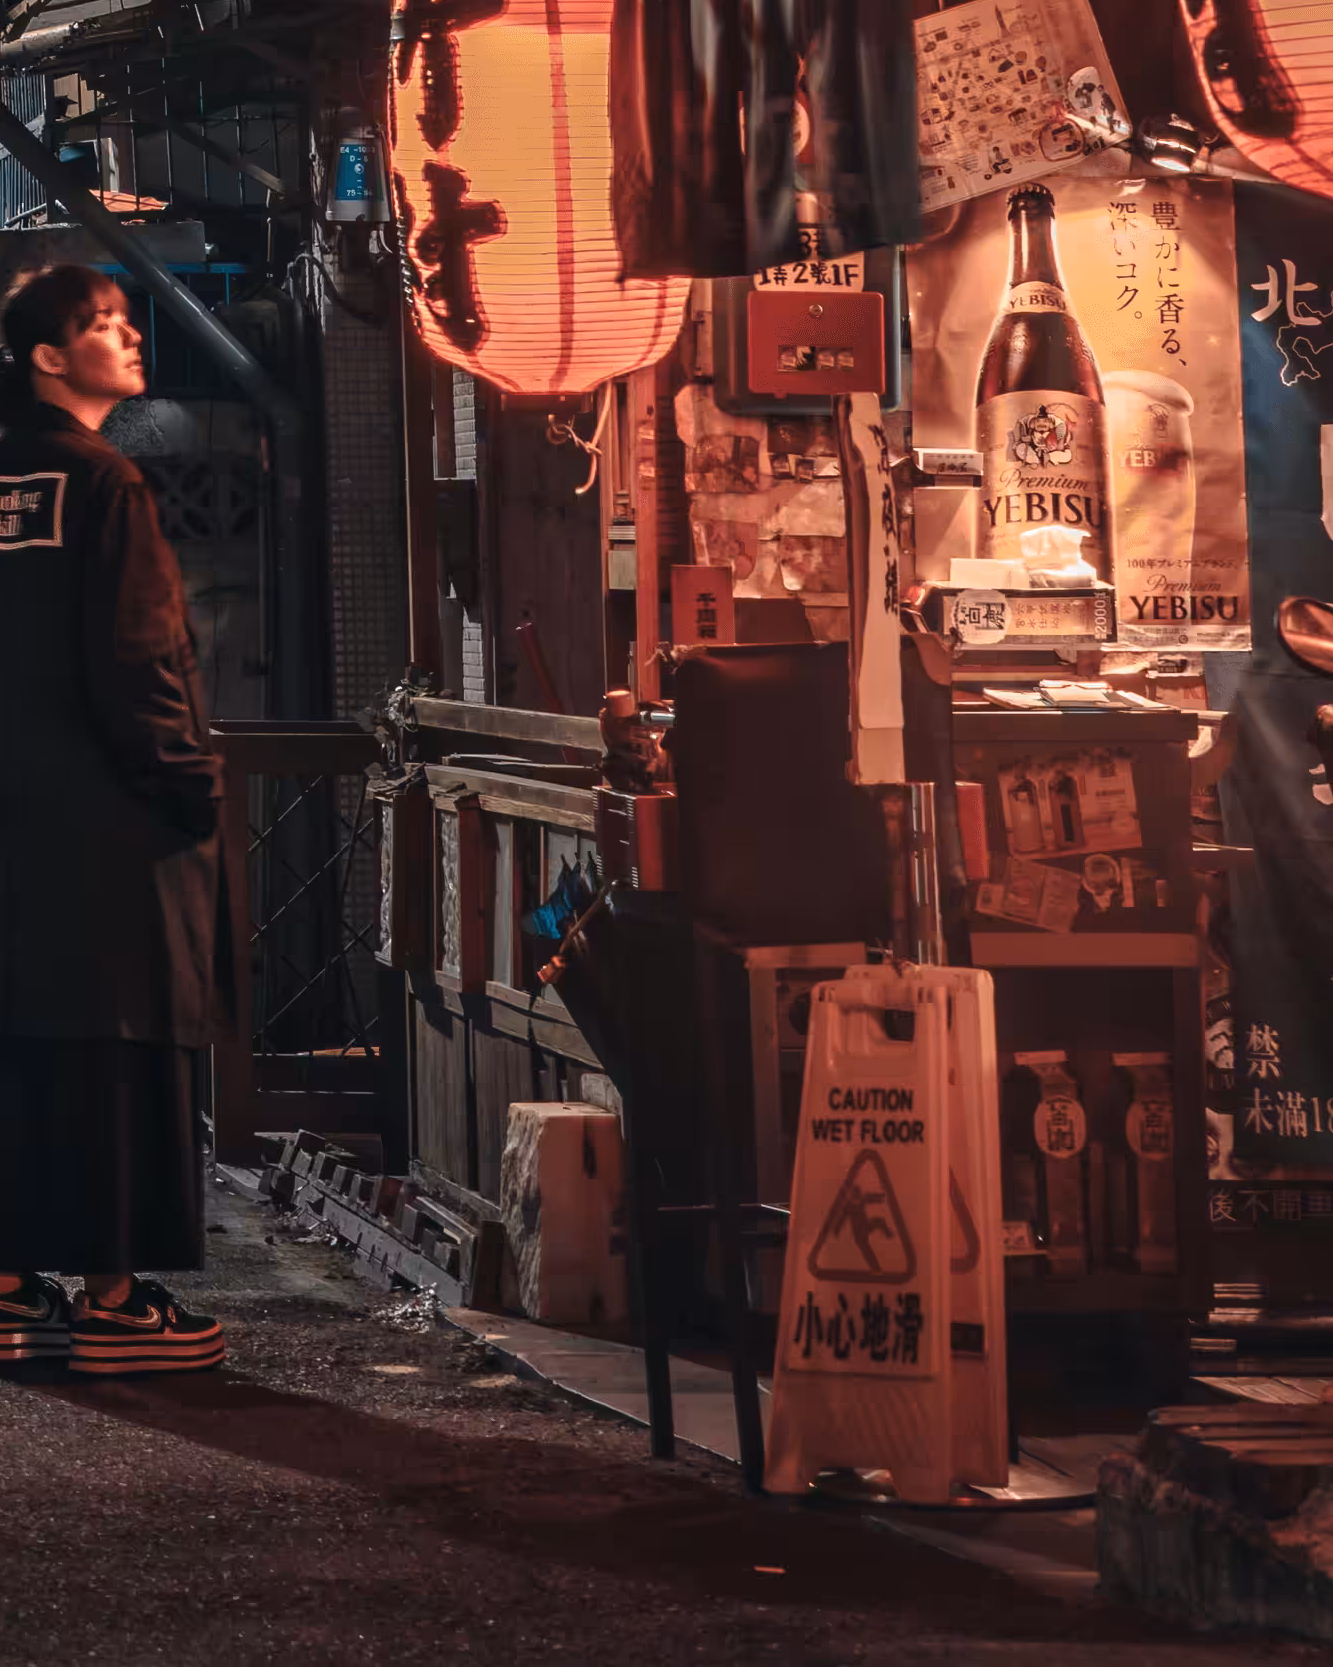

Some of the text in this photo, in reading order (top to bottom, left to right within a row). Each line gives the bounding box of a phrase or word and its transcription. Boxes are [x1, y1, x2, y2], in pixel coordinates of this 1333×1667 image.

[1107, 201, 1143, 320] 深いコク。
[1150, 201, 1187, 367] 豊かに香る、
[1009, 294, 1067, 311] YEBISU
[999, 467, 1088, 491] Premium
[984, 492, 1104, 529] YEBISU
[1143, 573, 1222, 593] Premium
[1129, 595, 1238, 620] YEBISU
[828, 1087, 914, 1111] CAUTION
[812, 1118, 925, 1144] WET FLOOR
[793, 1290, 925, 1364] 小心地滑
